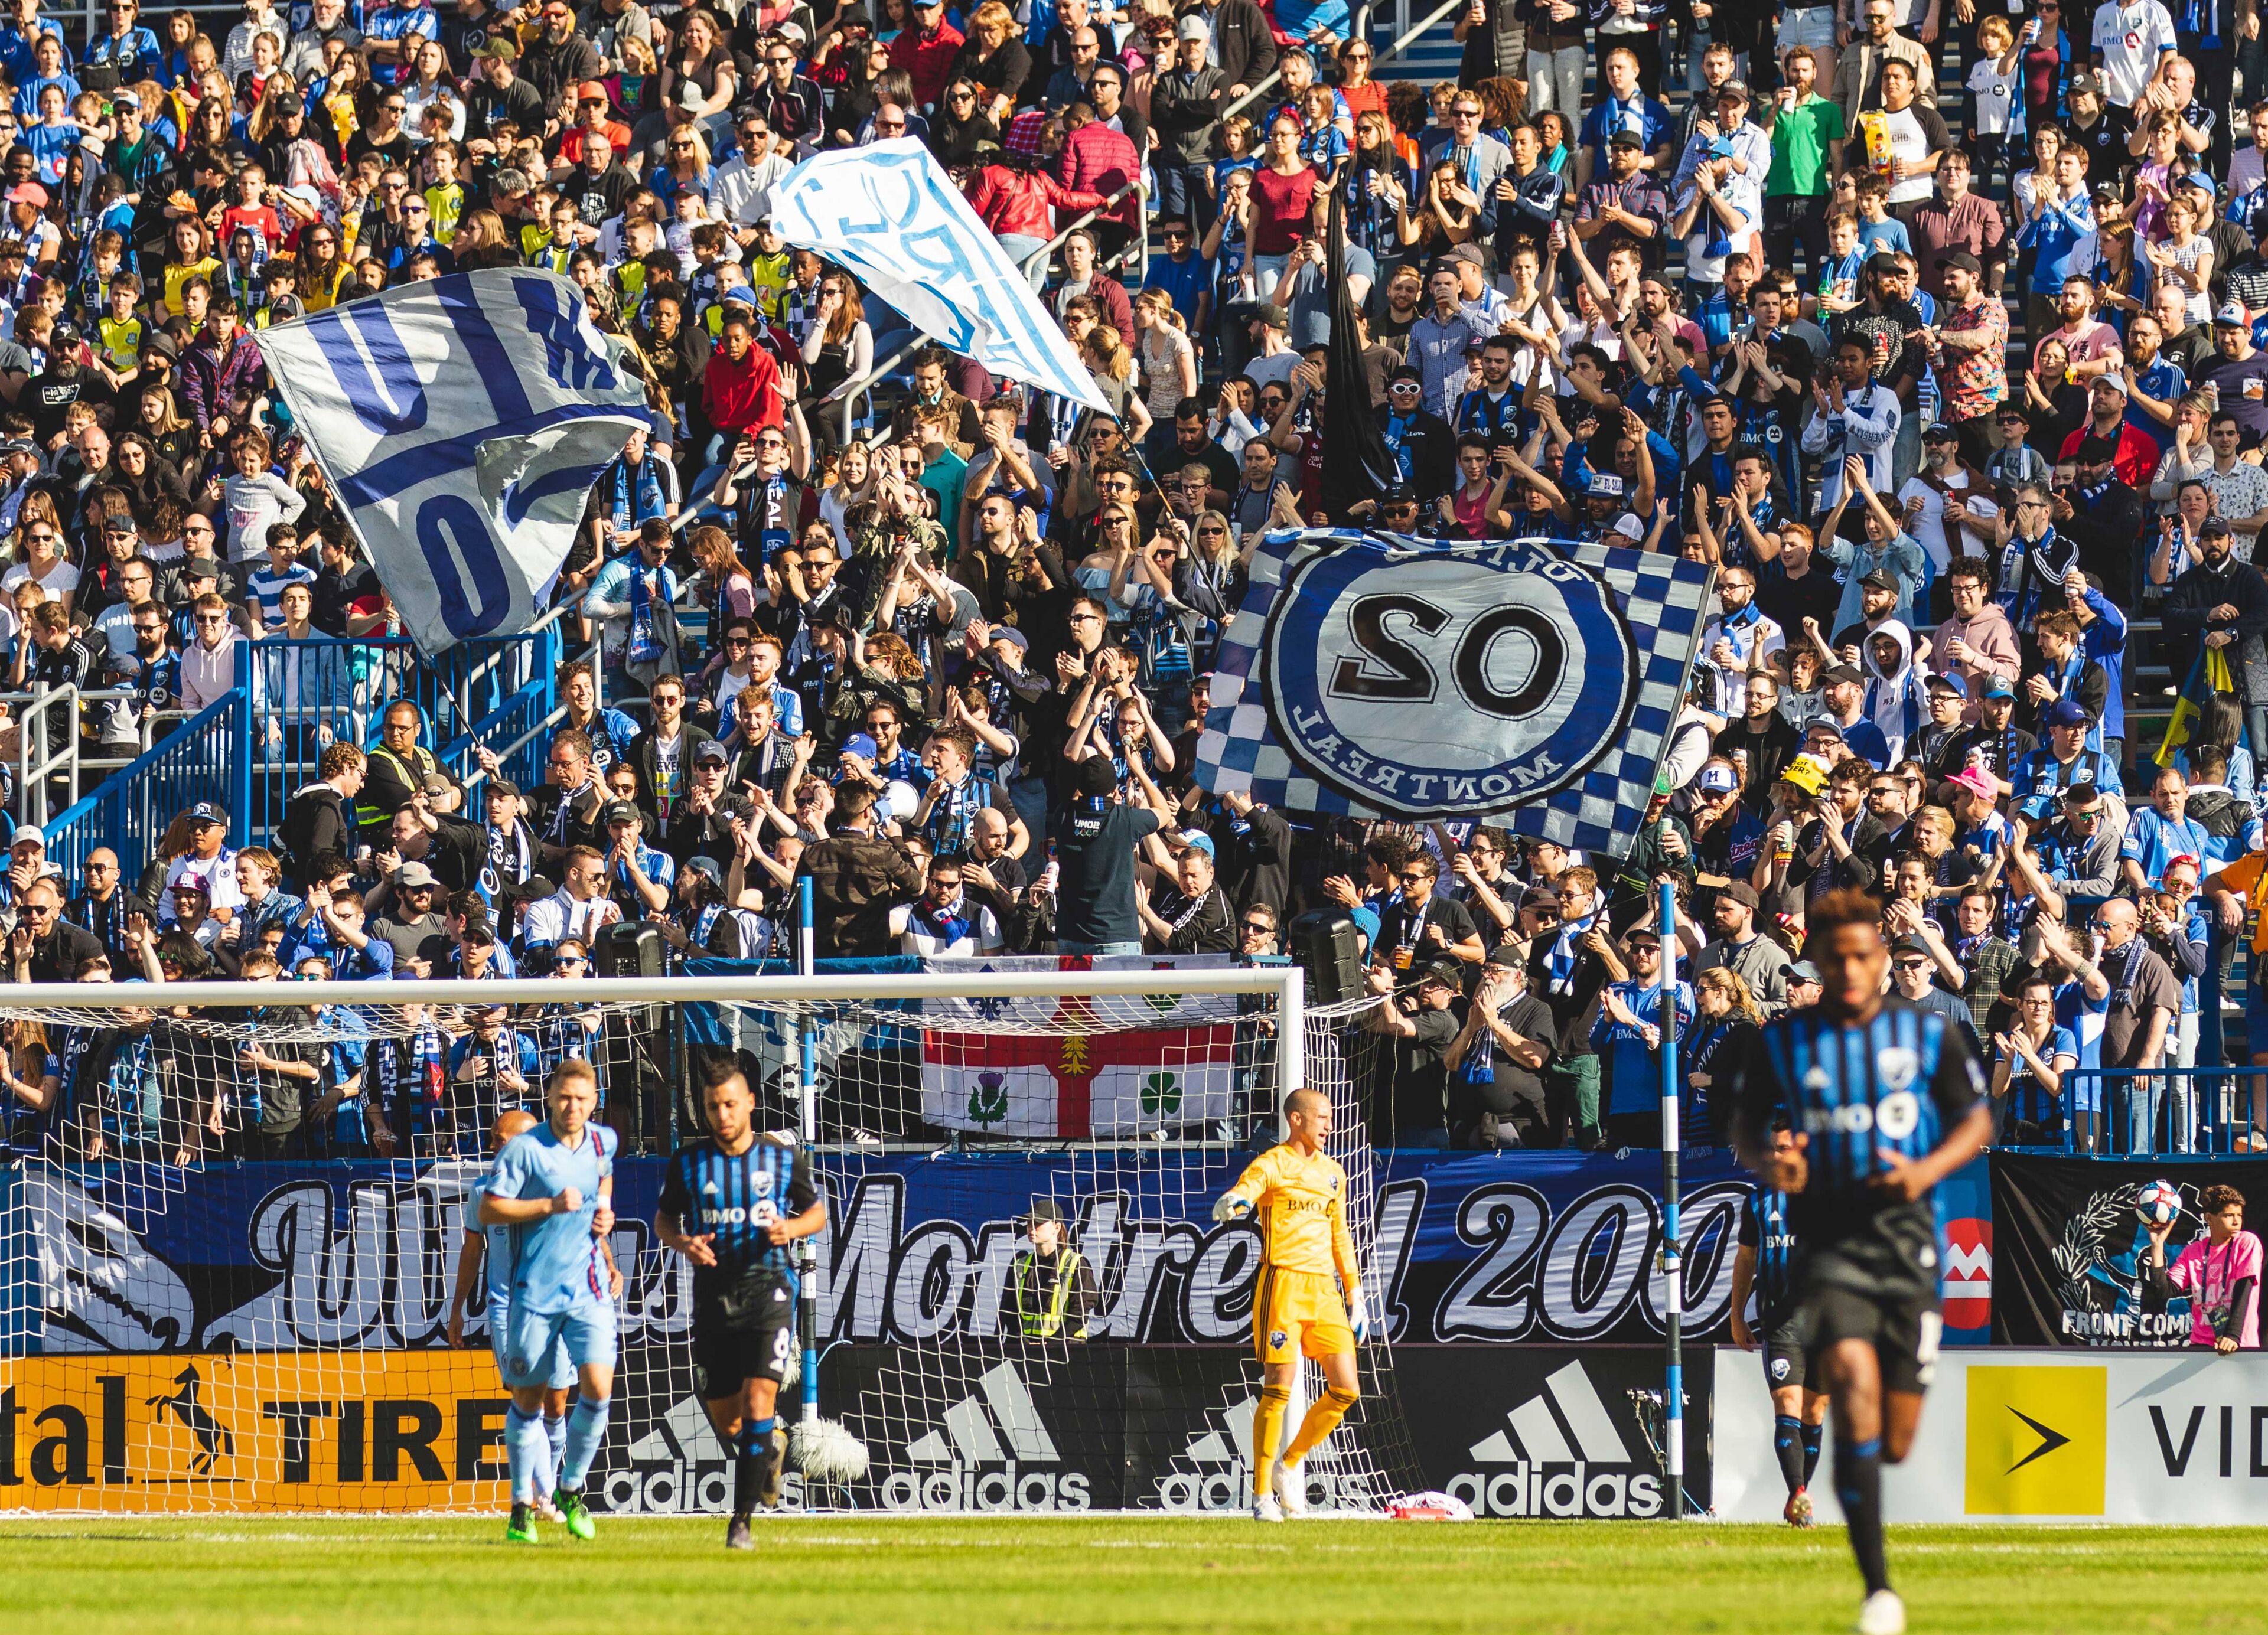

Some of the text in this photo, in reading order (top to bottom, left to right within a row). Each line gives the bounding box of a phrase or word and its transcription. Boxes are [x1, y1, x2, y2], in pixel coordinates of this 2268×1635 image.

[2102, 37, 2123, 45] BMO
[1472, 427, 1491, 437] BM
[1707, 771, 1719, 782] M
[2035, 785, 2057, 796] BM
[702, 1208, 746, 1225] BMO
[1288, 1200, 1322, 1213] BMO
[1433, 1182, 1758, 1343] 200
[2062, 1310, 2129, 1334] FRONT
[774, 1327, 790, 1359] 8
[603, 1460, 806, 1514] adids
[881, 1459, 1091, 1511] adidas
[1160, 1460, 1370, 1511] adias
[1446, 1460, 1662, 1517] adidas
